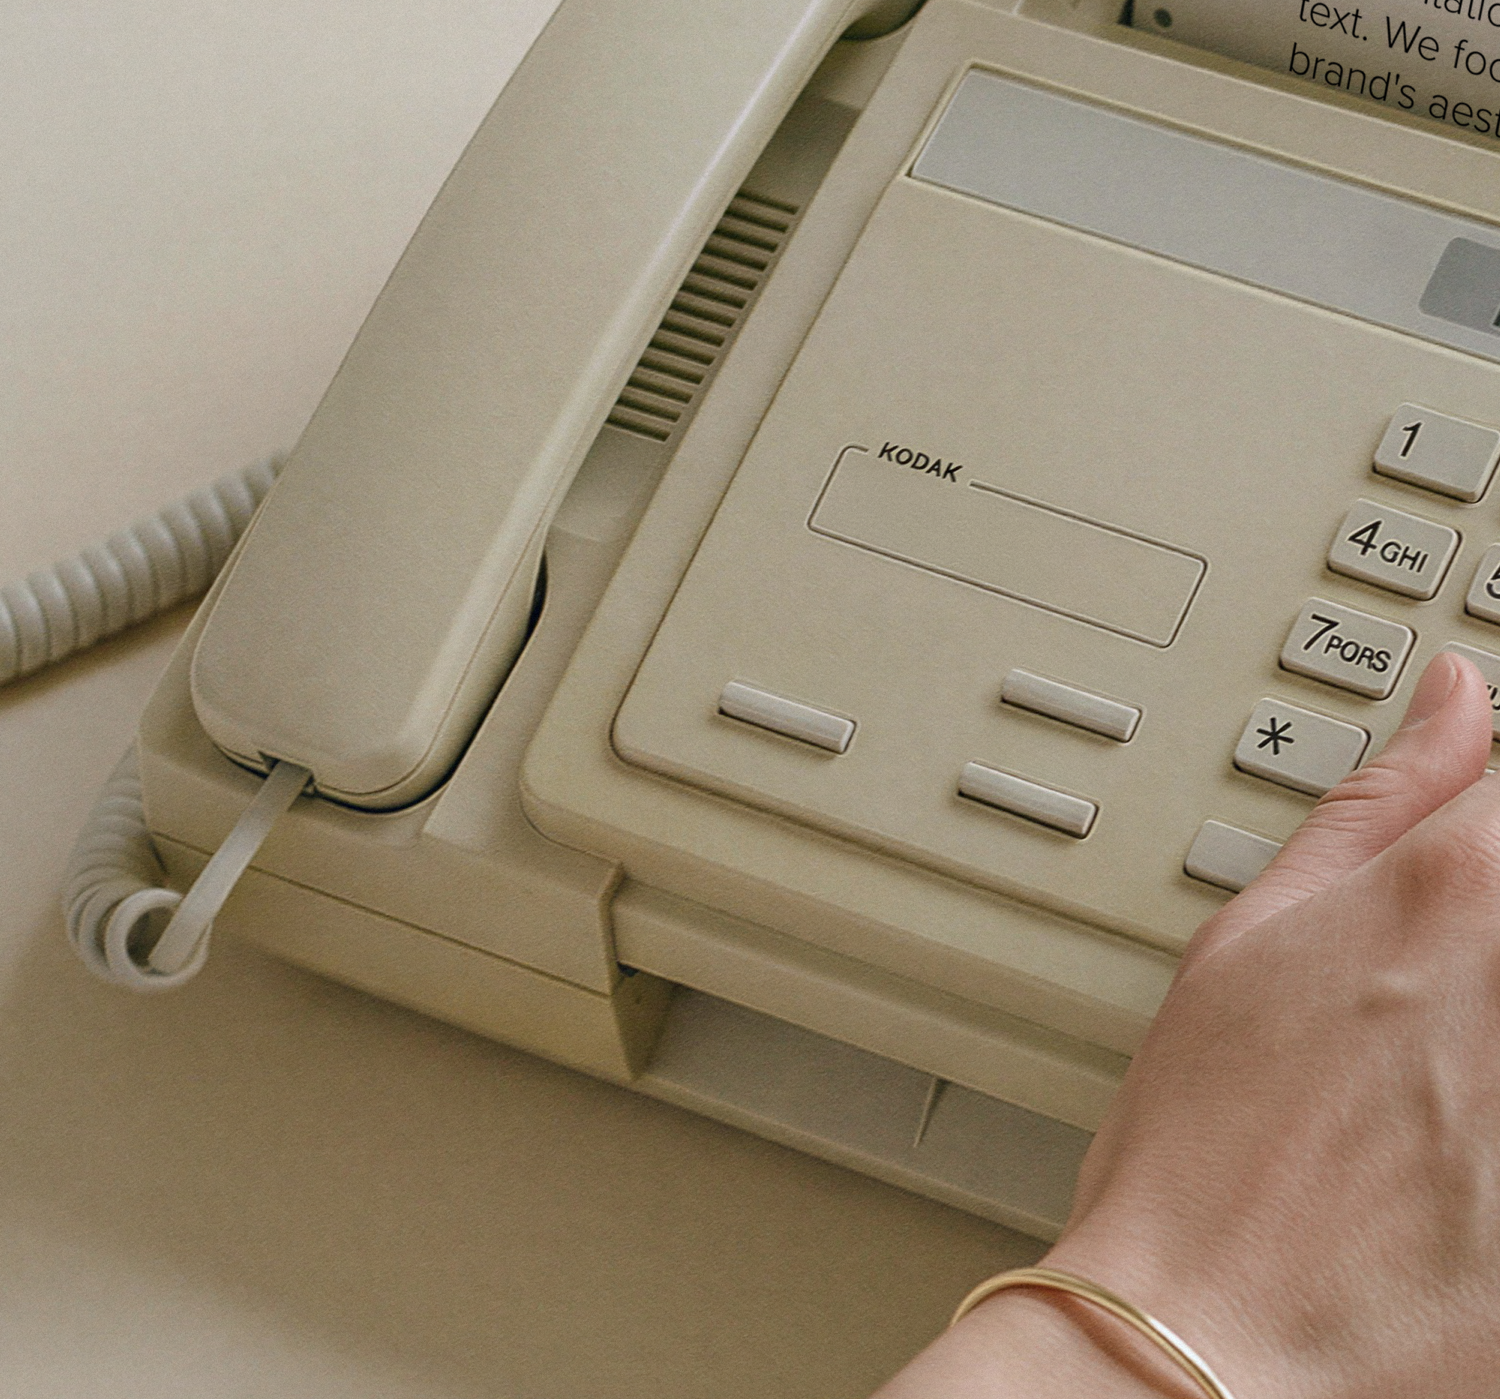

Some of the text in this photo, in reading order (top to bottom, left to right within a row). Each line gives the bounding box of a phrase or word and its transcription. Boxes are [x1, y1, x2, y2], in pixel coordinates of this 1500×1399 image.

[1385, 15, 1440, 62] We
[1288, 41, 1416, 110] brand's
[877, 441, 964, 483] KODAK
[1400, 422, 1422, 458] 1
